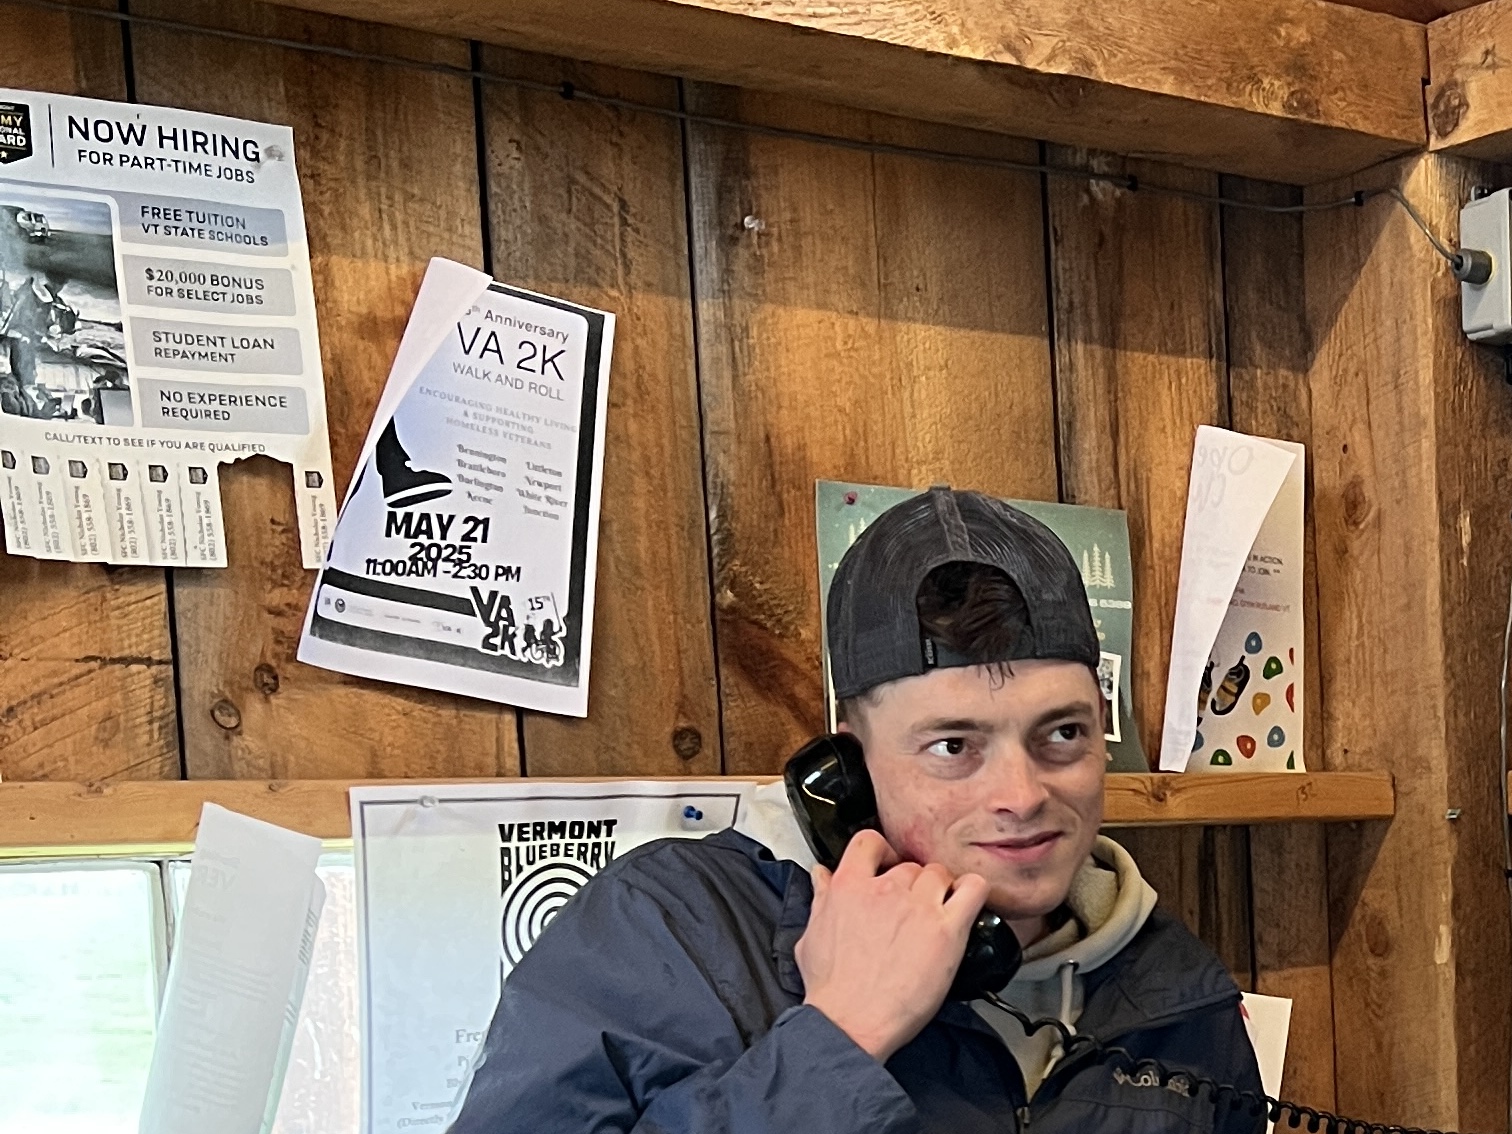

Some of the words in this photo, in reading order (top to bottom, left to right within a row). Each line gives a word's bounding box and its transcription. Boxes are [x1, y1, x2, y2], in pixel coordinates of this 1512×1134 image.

[67, 116, 146, 146] NOW
[158, 126, 260, 163] HIRING
[78, 150, 113, 167] FOR
[119, 155, 213, 177] PART-TIME
[217, 167, 255, 183] JOBS
[141, 206, 181, 221] FREE
[186, 211, 246, 229] TUITION
[141, 224, 159, 235] VT
[164, 226, 205, 239] STATE
[209, 230, 268, 246] SCHOOLS
[484, 309, 569, 344] Anniversary
[152, 331, 226, 348] STUDENT
[232, 337, 274, 350] LOAN
[457, 322, 504, 364] VA
[517, 341, 565, 381] 2K
[154, 348, 236, 363] REPAYMENT
[453, 362, 492, 382] WALK
[495, 374, 524, 390] AND
[528, 382, 564, 401] ROLL
[160, 390, 182, 403] NO
[188, 393, 288, 408] EXPERIENCE
[162, 408, 230, 421] REQUIRED
[385, 511, 455, 540] MAY
[461, 516, 490, 543] 21
[408, 542, 472, 562] 2025
[498, 819, 617, 843] VERMONT
[500, 841, 616, 897] BLUEBERRY
